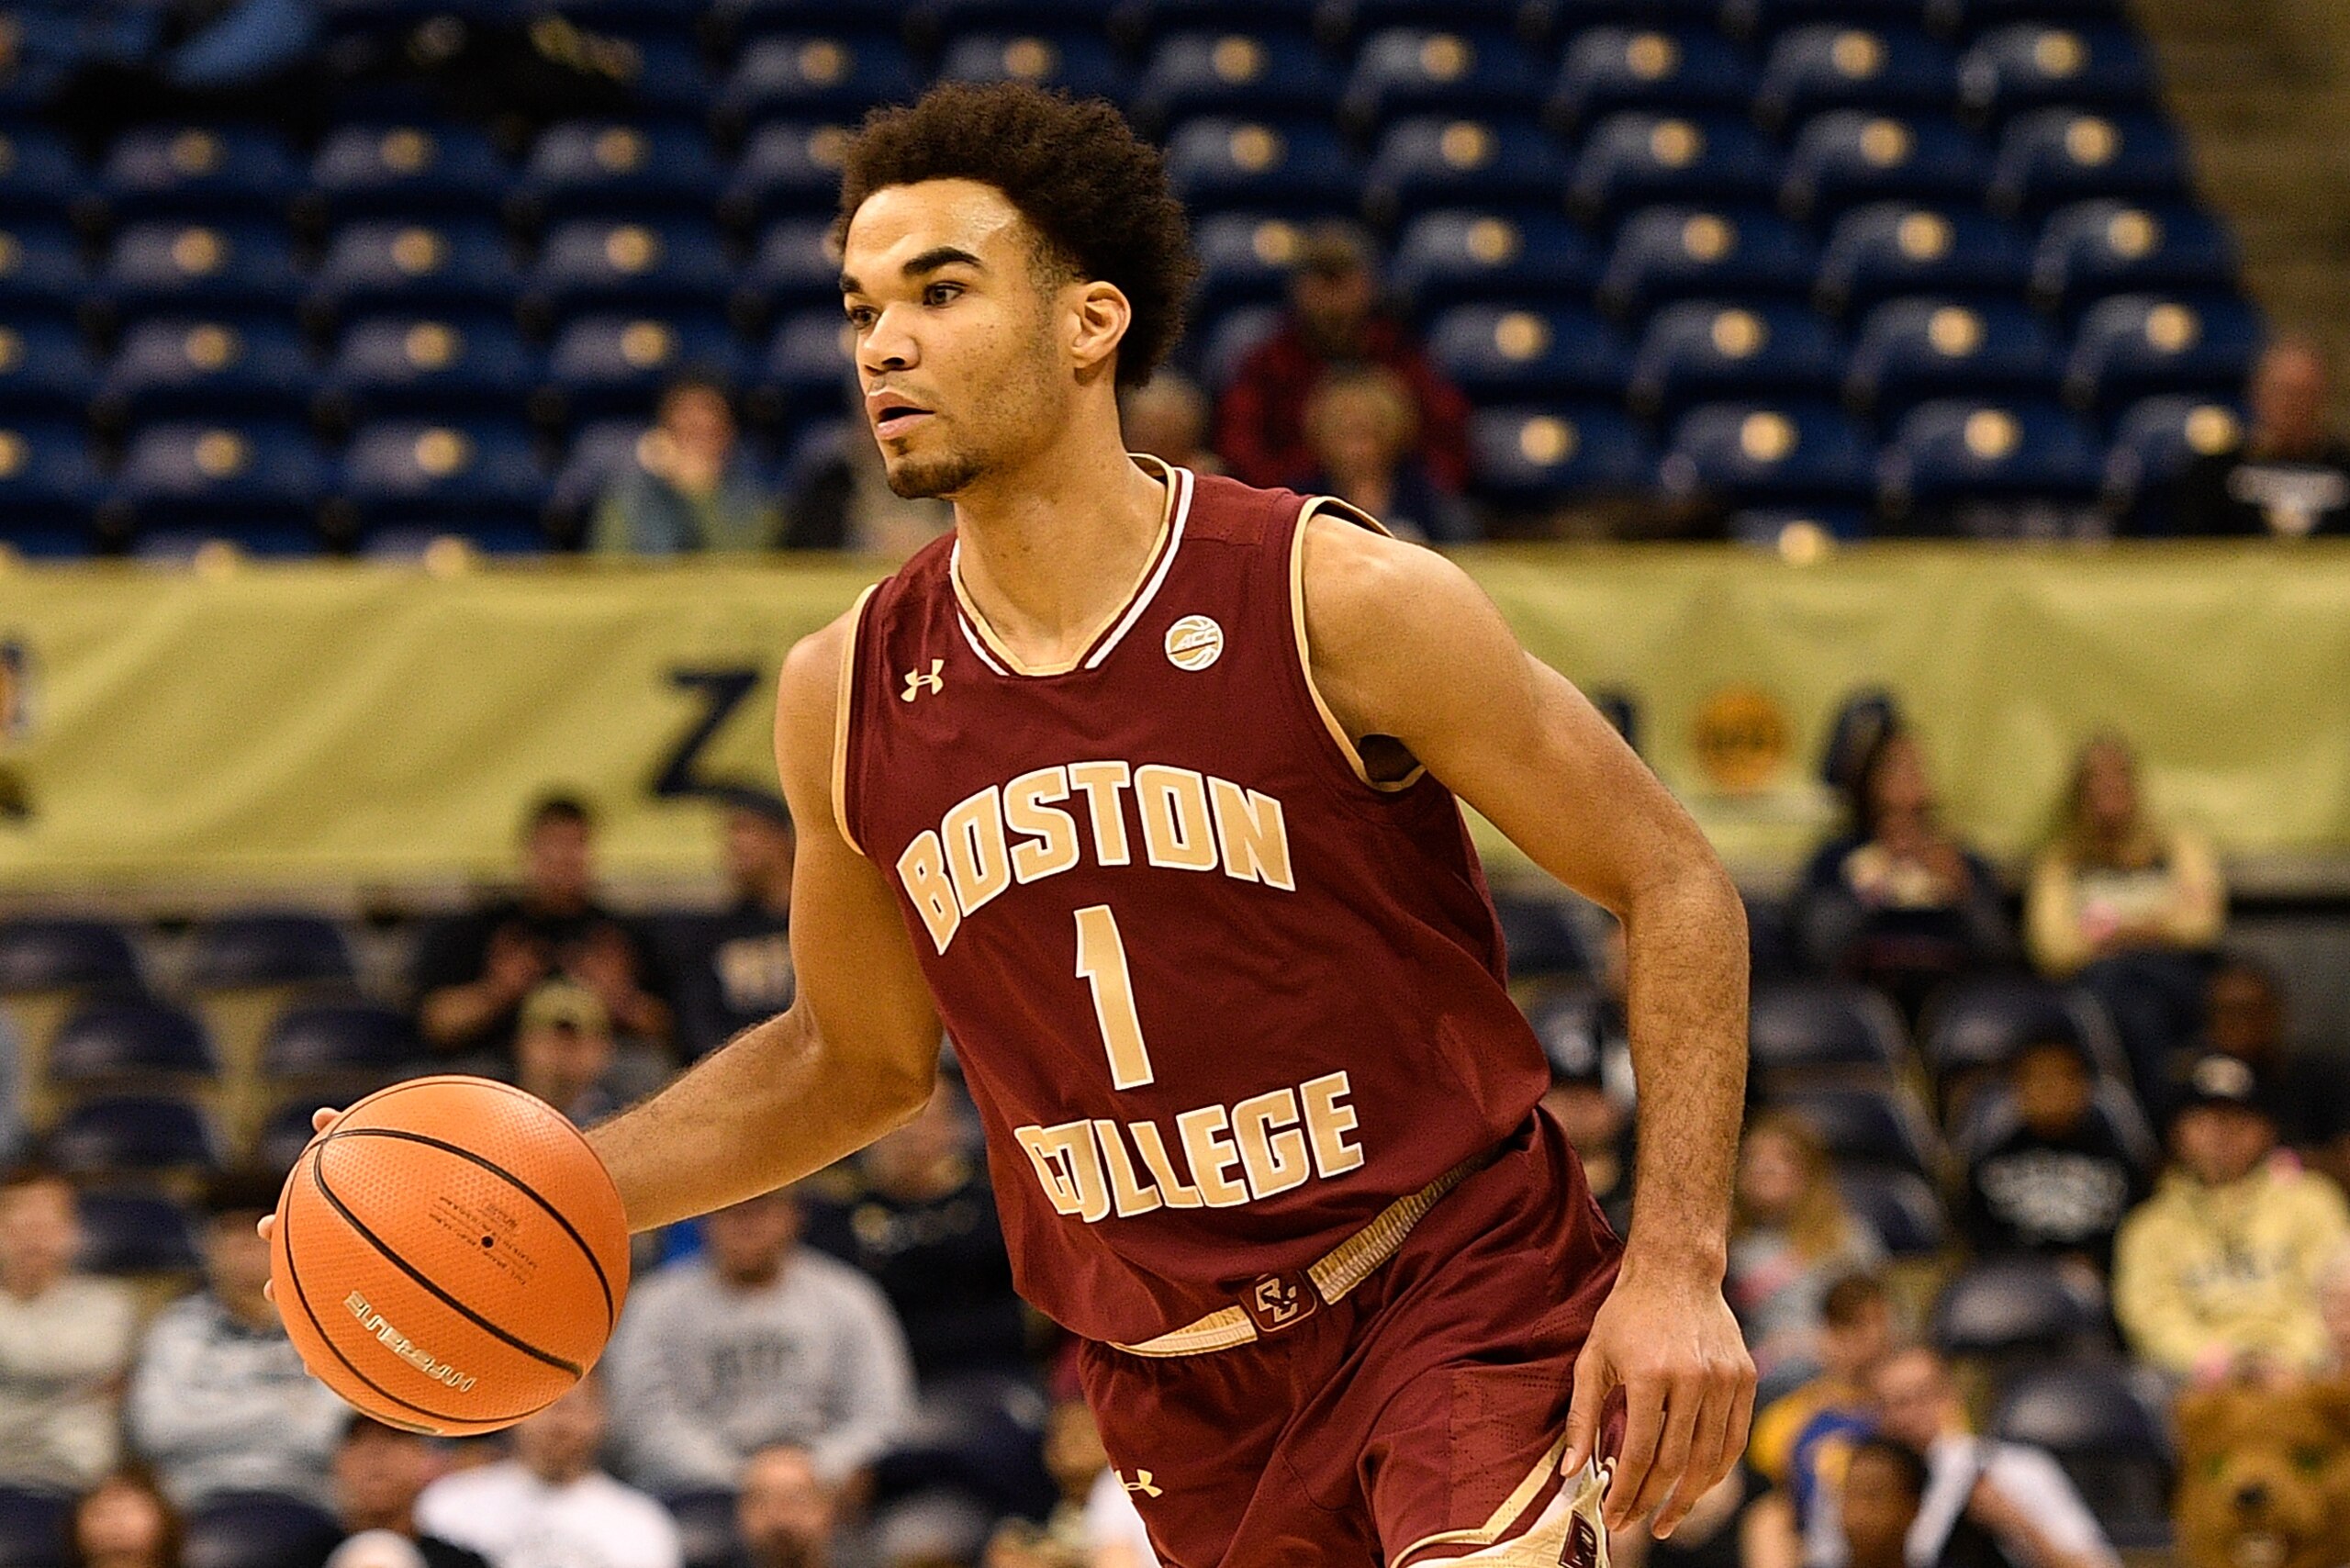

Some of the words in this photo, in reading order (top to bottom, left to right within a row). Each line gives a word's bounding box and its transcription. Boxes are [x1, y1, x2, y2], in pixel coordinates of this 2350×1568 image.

[896, 761, 1295, 956] BOSTON
[1074, 904, 1154, 1091] 1
[1014, 1070, 1364, 1223] COLLEGE
